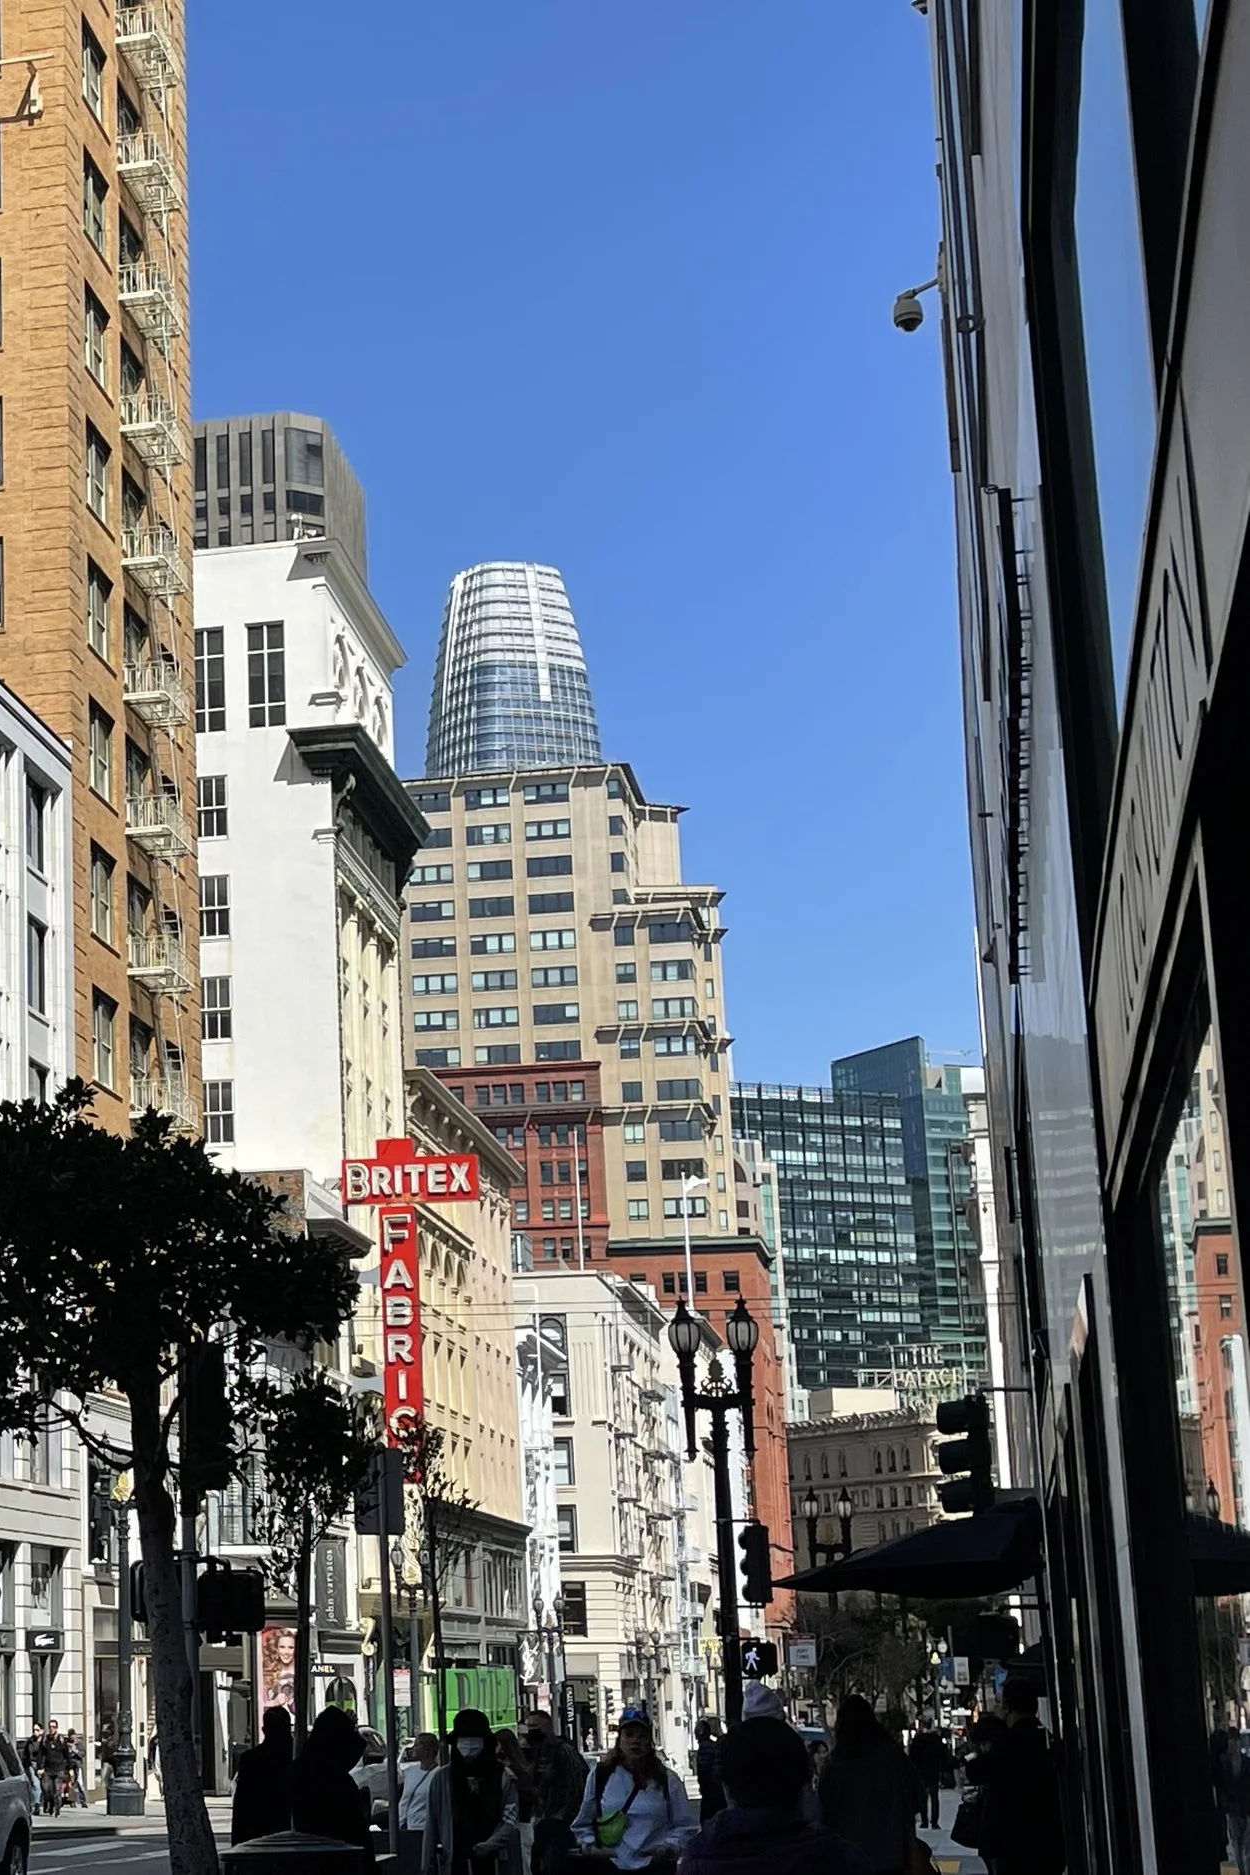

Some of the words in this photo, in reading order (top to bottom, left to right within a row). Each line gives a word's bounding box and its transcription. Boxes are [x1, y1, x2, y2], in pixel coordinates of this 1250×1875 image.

[346, 1163, 472, 1200] BRITEX
[382, 1214, 417, 1474] FABRIC
[909, 1344, 944, 1365] THE
[893, 1367, 963, 1389] PALACE
[325, 1549, 335, 1595] varvatos
[325, 1598, 338, 1623] john
[310, 1664, 335, 1673] ANEL
